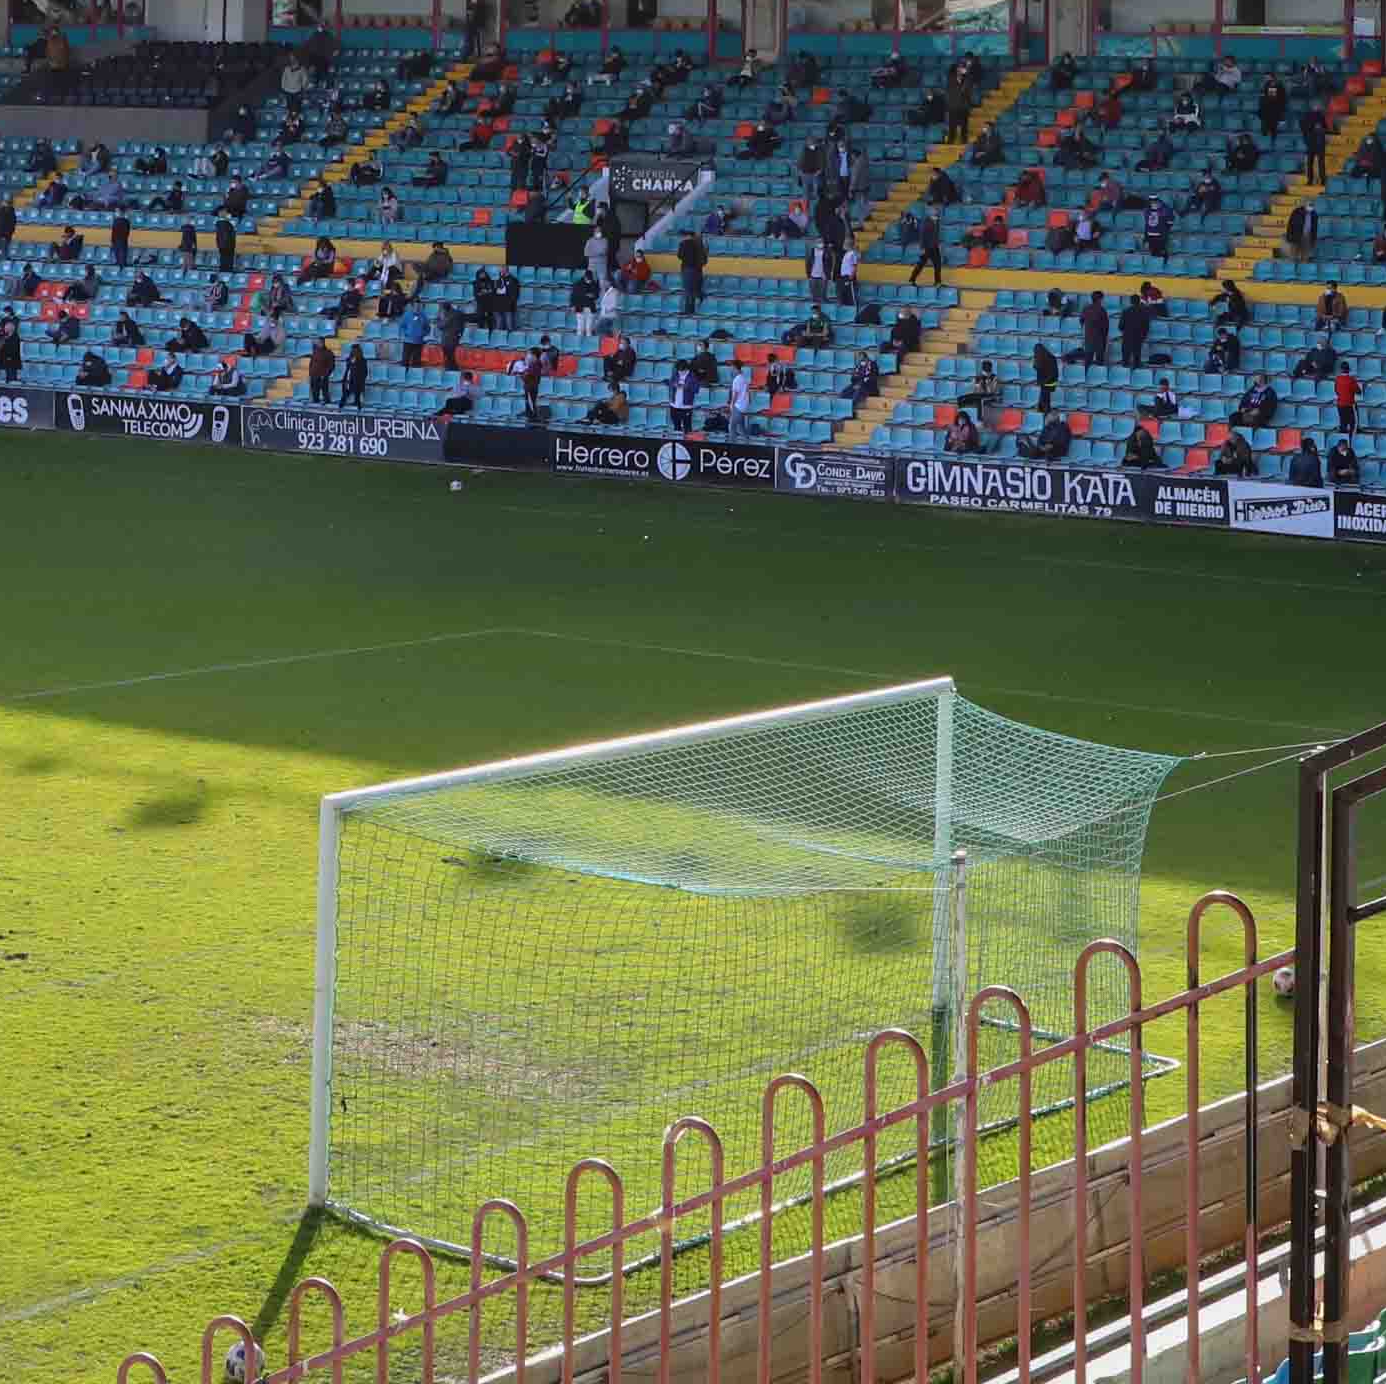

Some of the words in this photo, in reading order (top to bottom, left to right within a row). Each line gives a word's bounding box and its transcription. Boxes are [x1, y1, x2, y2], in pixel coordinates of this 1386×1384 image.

[121, 419, 183, 438] TELECOM
[319, 415, 359, 435] Dental
[362, 417, 440, 441] URBINA
[298, 431, 324, 450] 923
[328, 434, 354, 453] 281
[359, 438, 388, 456] 690
[556, 438, 650, 468] Herrero
[700, 448, 771, 479] Pérez
[1064, 471, 1137, 507] KATA
[1157, 485, 1221, 503] ALMACÉN
[930, 494, 982, 507] PASEO
[988, 498, 1089, 515] CARMELITAS
[1094, 506, 1112, 517] 79
[1154, 500, 1173, 515] DE
[1176, 502, 1224, 519] HIERRO
